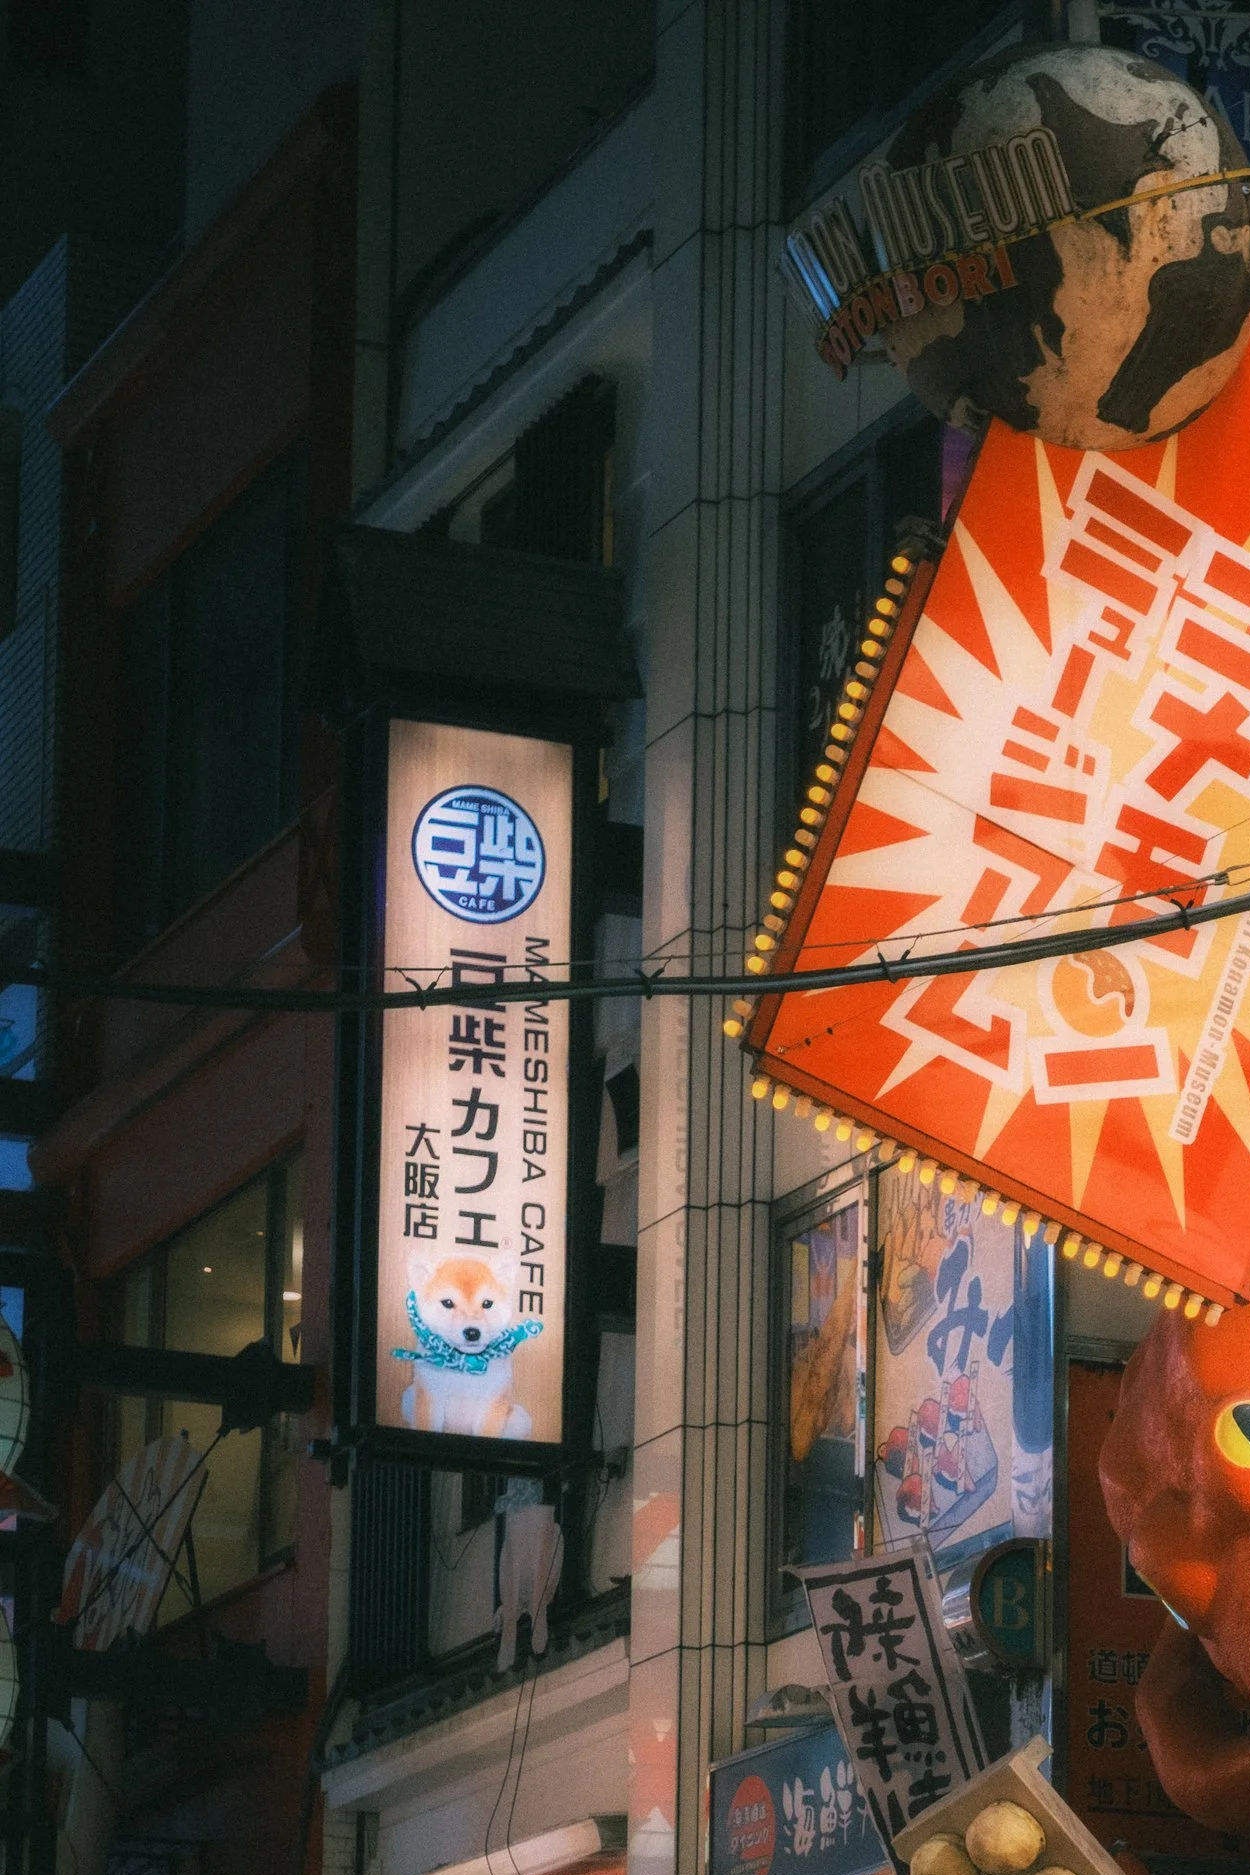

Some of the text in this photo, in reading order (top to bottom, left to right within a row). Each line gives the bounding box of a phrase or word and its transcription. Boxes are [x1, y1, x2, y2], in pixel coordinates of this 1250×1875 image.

[858, 126, 1073, 272] MUSEUM
[452, 800, 511, 816] MAME SHIBA
[900, 465, 1198, 1075] ミュージアム
[417, 808, 541, 900] 豆柴
[458, 896, 496, 911] CAFE
[447, 947, 506, 1249] 豆柴カフェ
[403, 1123, 440, 1240] 大阪店
[519, 1201, 546, 1314] CAFE
[1087, 1698, 1150, 1750] お
